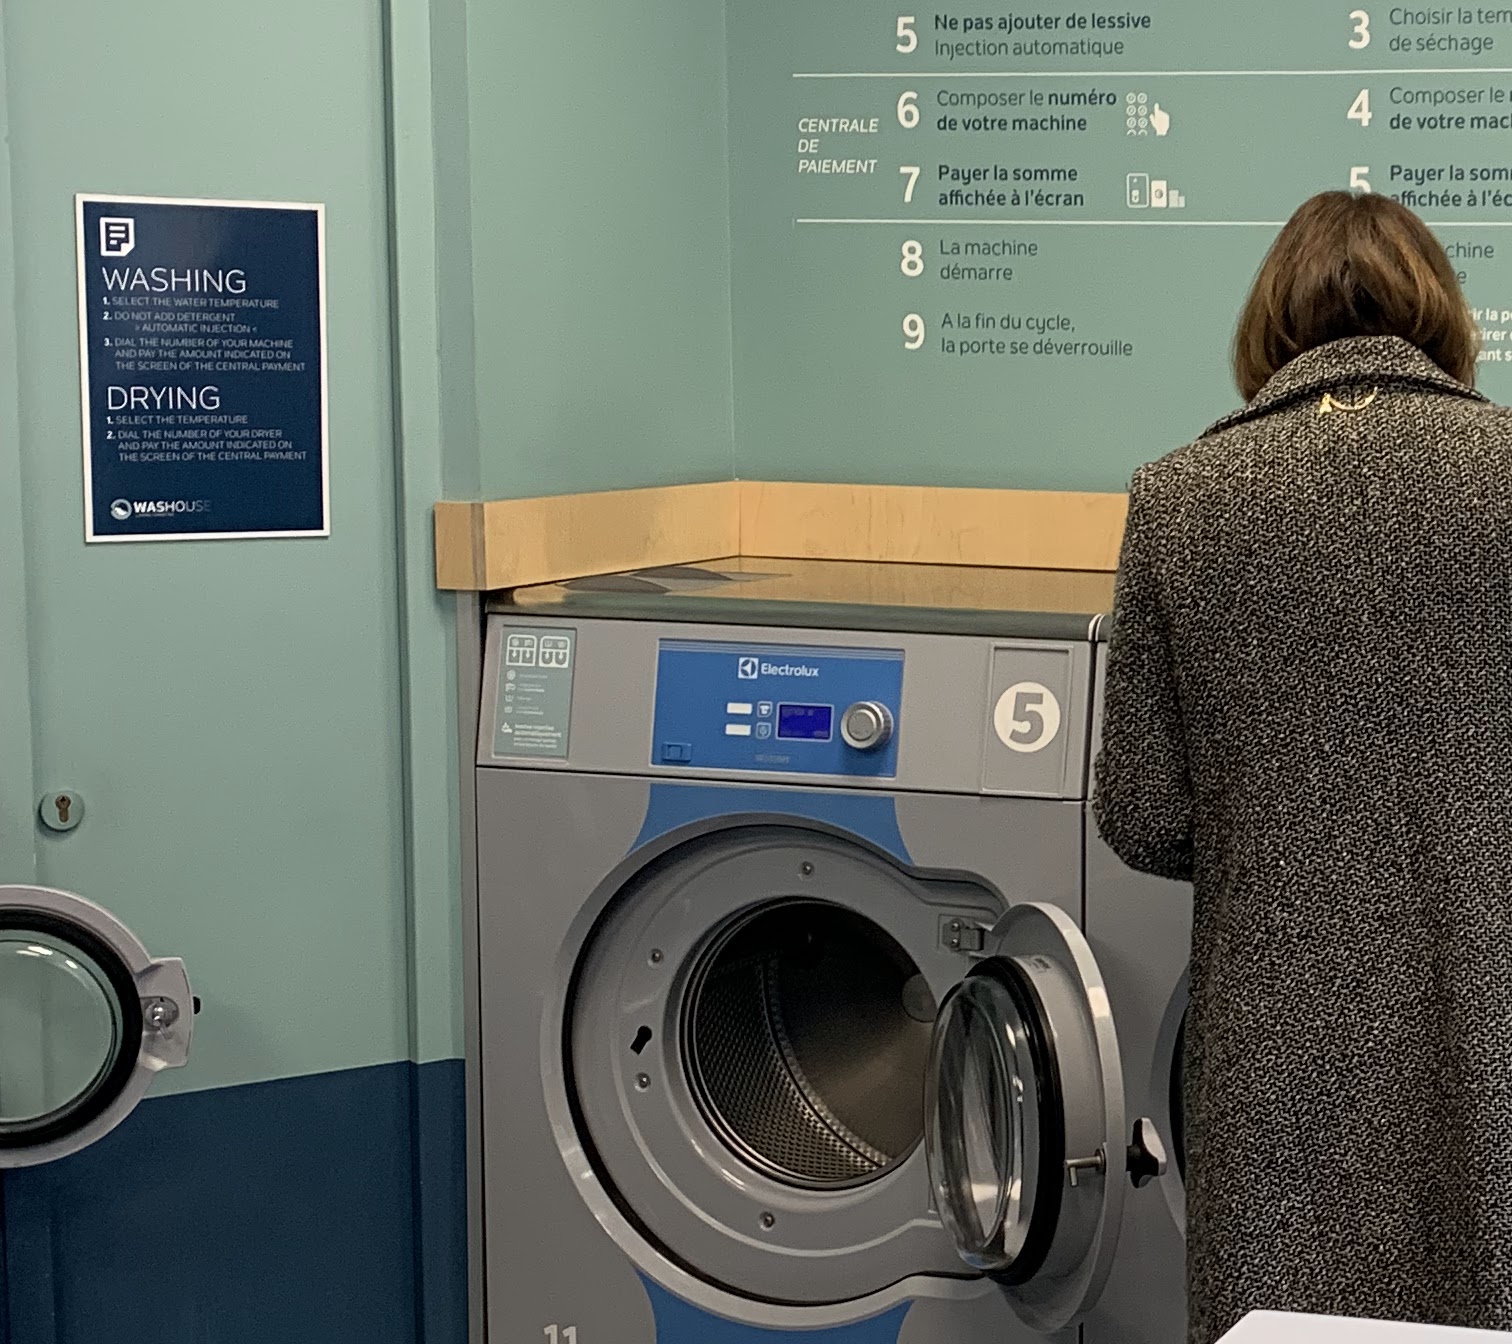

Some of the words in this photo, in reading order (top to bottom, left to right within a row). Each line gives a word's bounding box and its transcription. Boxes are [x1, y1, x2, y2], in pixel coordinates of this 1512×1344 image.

[895, 16, 918, 54] 5
[934, 14, 959, 31] Ne
[963, 17, 994, 34] pas
[997, 12, 1062, 35] ajouter
[1065, 12, 1087, 30] de
[1091, 11, 1151, 29] lessive
[1347, 9, 1372, 50] 3
[1389, 7, 1454, 26] Choisir
[1457, 7, 1473, 25] la
[935, 38, 1009, 61] Injection
[1012, 38, 1125, 58] automatique
[1388, 34, 1412, 52] de
[1416, 32, 1494, 56] séchage
[896, 90, 921, 129] 6
[936, 89, 1026, 110] Composer
[1029, 89, 1044, 107] le
[1048, 87, 1117, 106] numéro
[798, 117, 880, 133] CENTRALE
[936, 114, 958, 131] de
[961, 115, 1008, 132] votre
[1012, 114, 1087, 132] machine
[797, 138, 820, 154] DE
[798, 159, 878, 174] PAIEMENT
[898, 165, 921, 203] 7
[938, 164, 990, 186] Payer
[993, 164, 1009, 182] la
[1012, 168, 1078, 182] somme
[1349, 165, 1372, 194] 5
[1390, 164, 1445, 187] Payer
[1449, 164, 1465, 181] la
[938, 188, 1007, 207] affichée
[1010, 188, 1021, 207] à
[1024, 188, 1084, 207] l'écran
[1466, 189, 1478, 208] à
[1445, 241, 1495, 259] chine
[101, 266, 247, 294] WASHING
[111, 296, 150, 307] SELECT
[151, 296, 172, 307] THE
[173, 297, 208, 308] WATER
[208, 298, 280, 309] TEMPERATURE
[113, 311, 131, 321] DO
[131, 311, 152, 322] NOT
[153, 312, 176, 322] ADD
[176, 312, 236, 323] DETERGENT
[1485, 307, 1499, 322] la
[141, 323, 199, 333] AUTOMATIC
[199, 323, 251, 334] INJECTION
[902, 313, 926, 350] 9
[957, 312, 971, 329] la
[975, 312, 996, 329] fin
[999, 313, 1022, 331] du
[1025, 313, 1076, 335] cycle,
[941, 337, 956, 354] la
[959, 338, 1006, 357] porte
[1009, 341, 1029, 355] se
[1032, 337, 1133, 357] déverrouille
[107, 385, 221, 411] DRYING
[115, 415, 153, 425] SELECT
[156, 415, 176, 425] THE
[176, 414, 249, 425] TEMPERATURE
[132, 499, 212, 514] WASHOUSE
[760, 662, 820, 678] Electrolux
[1008, 691, 1045, 746] 5
